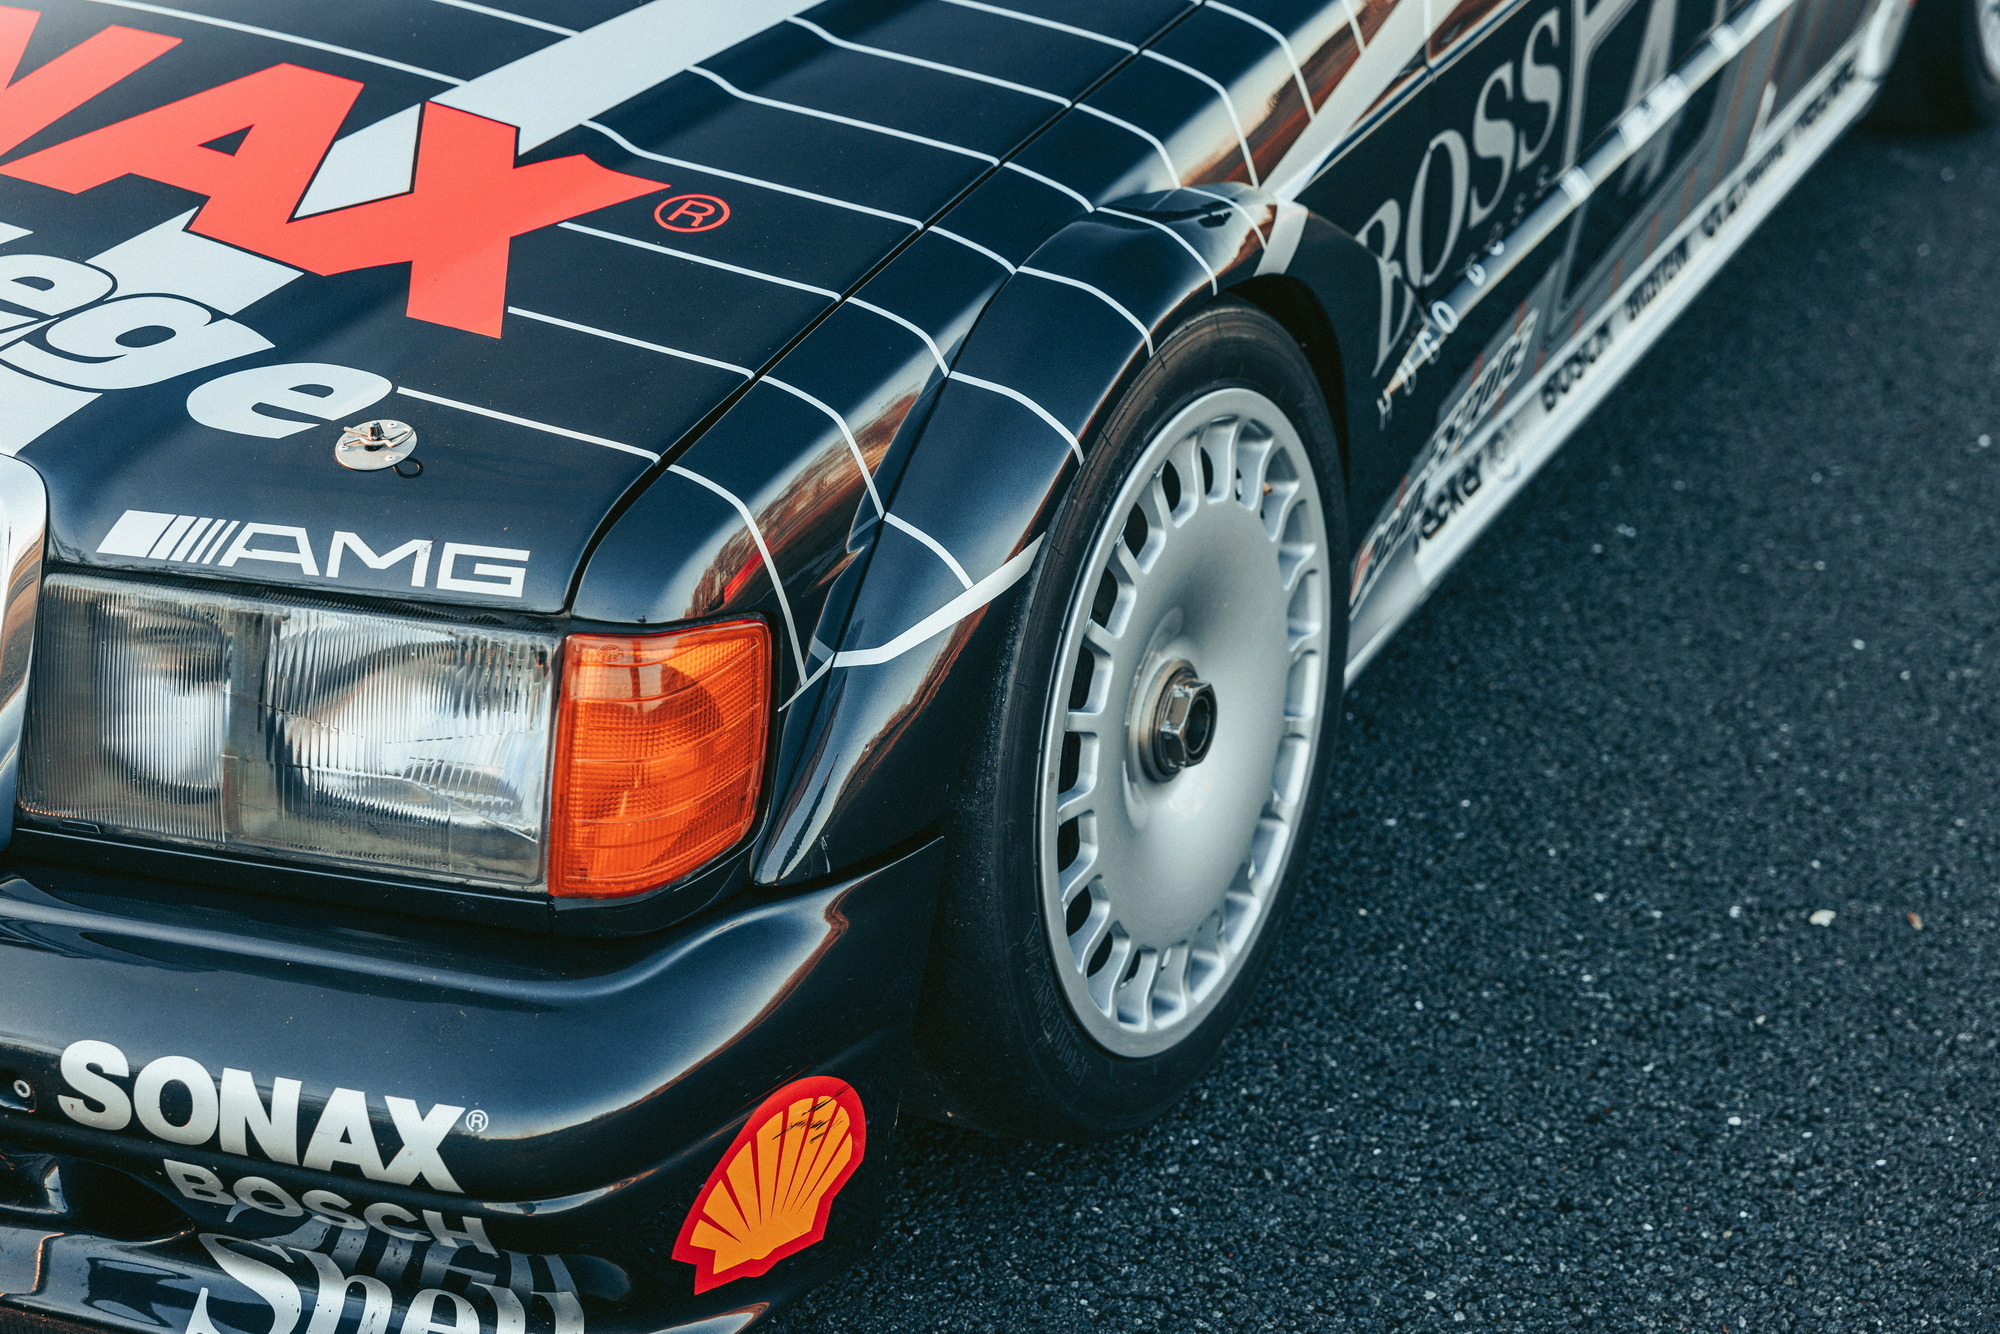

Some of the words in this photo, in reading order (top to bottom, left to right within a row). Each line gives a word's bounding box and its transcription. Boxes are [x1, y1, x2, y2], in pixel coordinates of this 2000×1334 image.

[1356, 8, 1561, 378] BOSS
[218, 520, 531, 598] AMG
[163, 1159, 500, 1258] BOSCH
